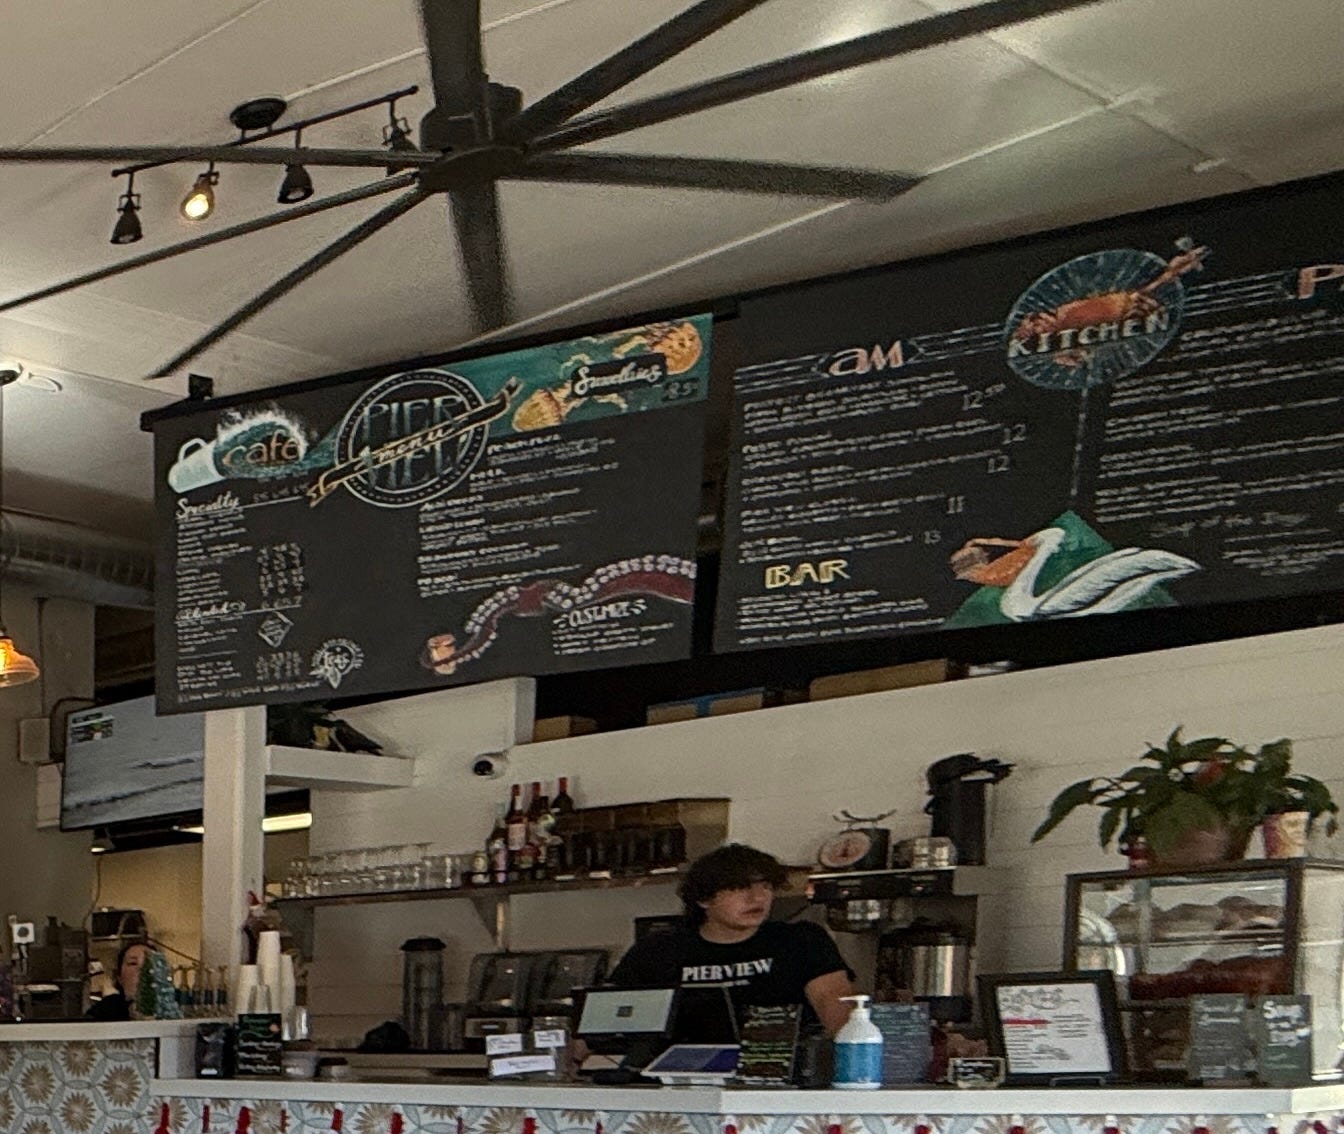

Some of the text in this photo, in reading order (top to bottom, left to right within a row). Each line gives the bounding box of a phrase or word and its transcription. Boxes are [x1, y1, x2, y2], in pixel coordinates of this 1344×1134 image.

[1008, 310, 1170, 358] KITCHEN
[764, 558, 852, 590] BAR
[680, 956, 775, 983] PIERVIEW
